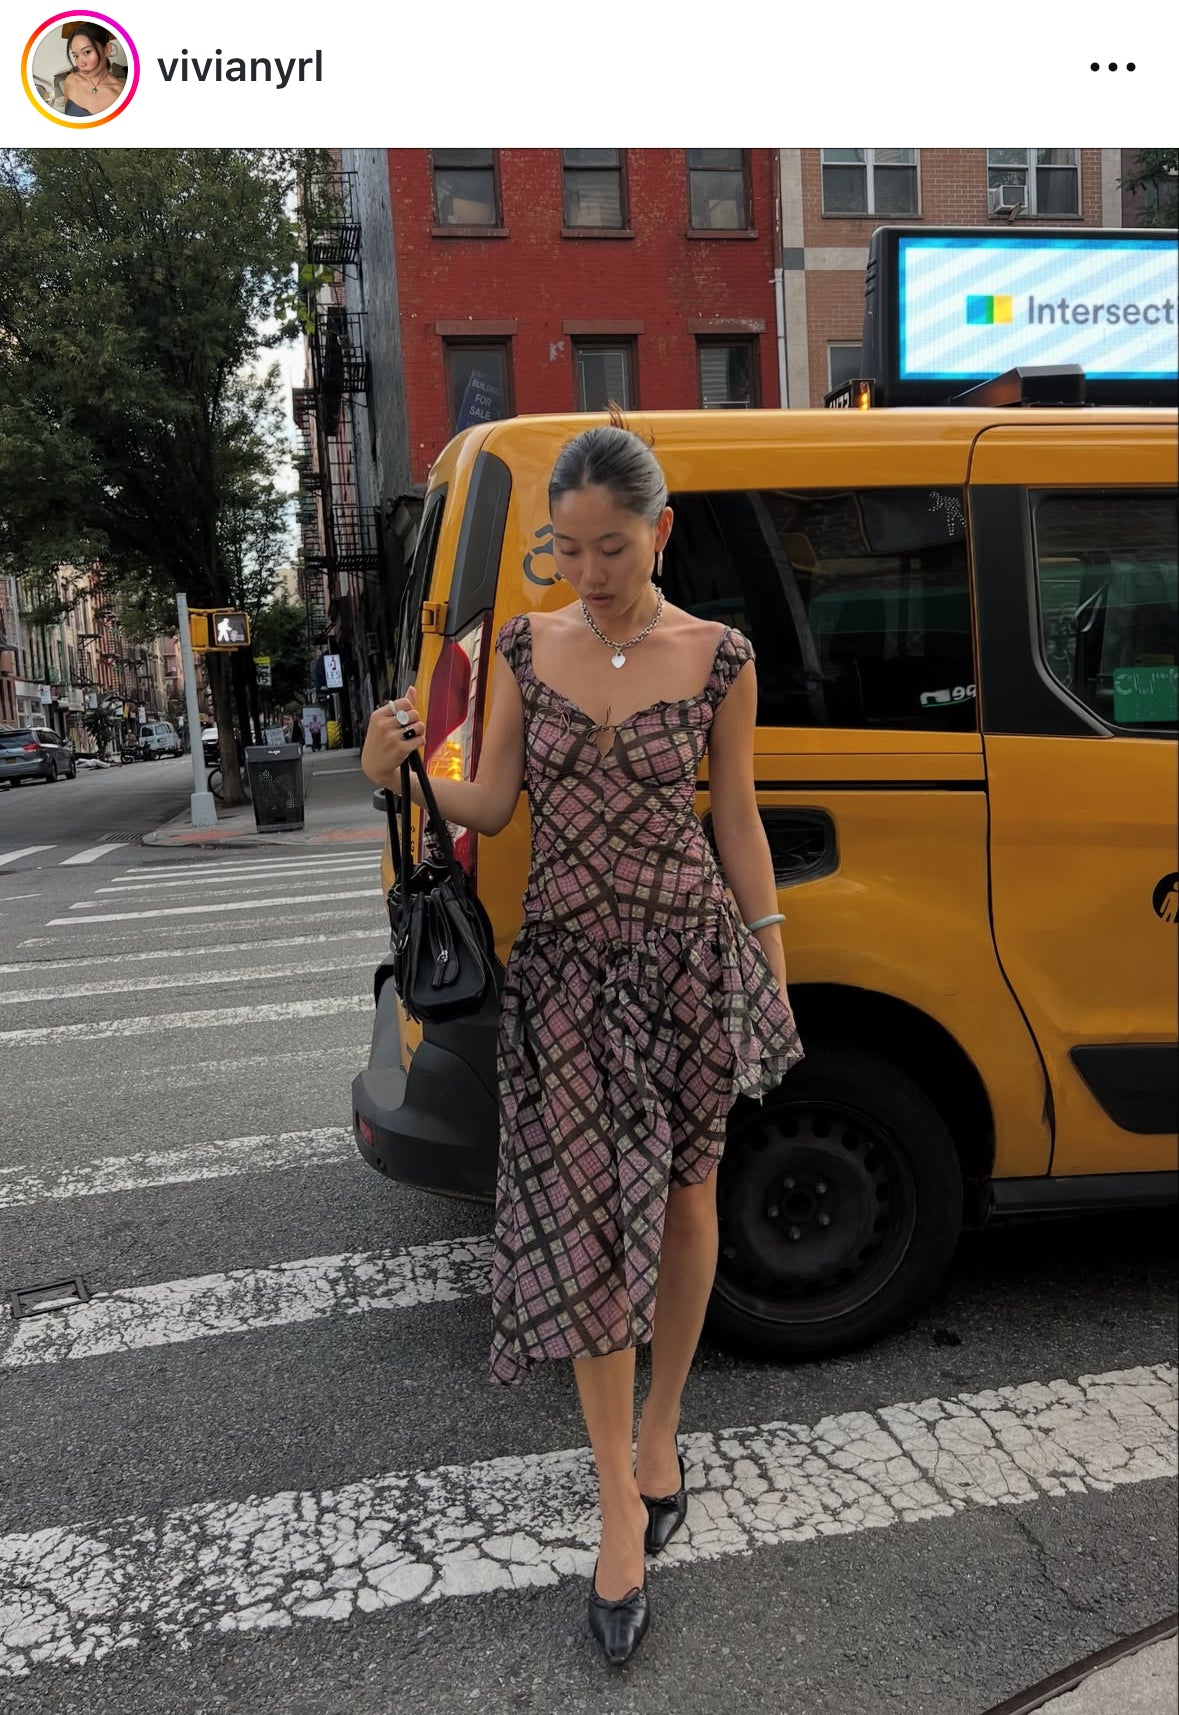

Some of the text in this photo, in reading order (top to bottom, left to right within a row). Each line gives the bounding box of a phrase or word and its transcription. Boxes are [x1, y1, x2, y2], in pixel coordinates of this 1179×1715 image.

[1028, 295, 1175, 326] Intersect
[475, 393, 492, 407] FOR
[469, 405, 491, 421] SALE
